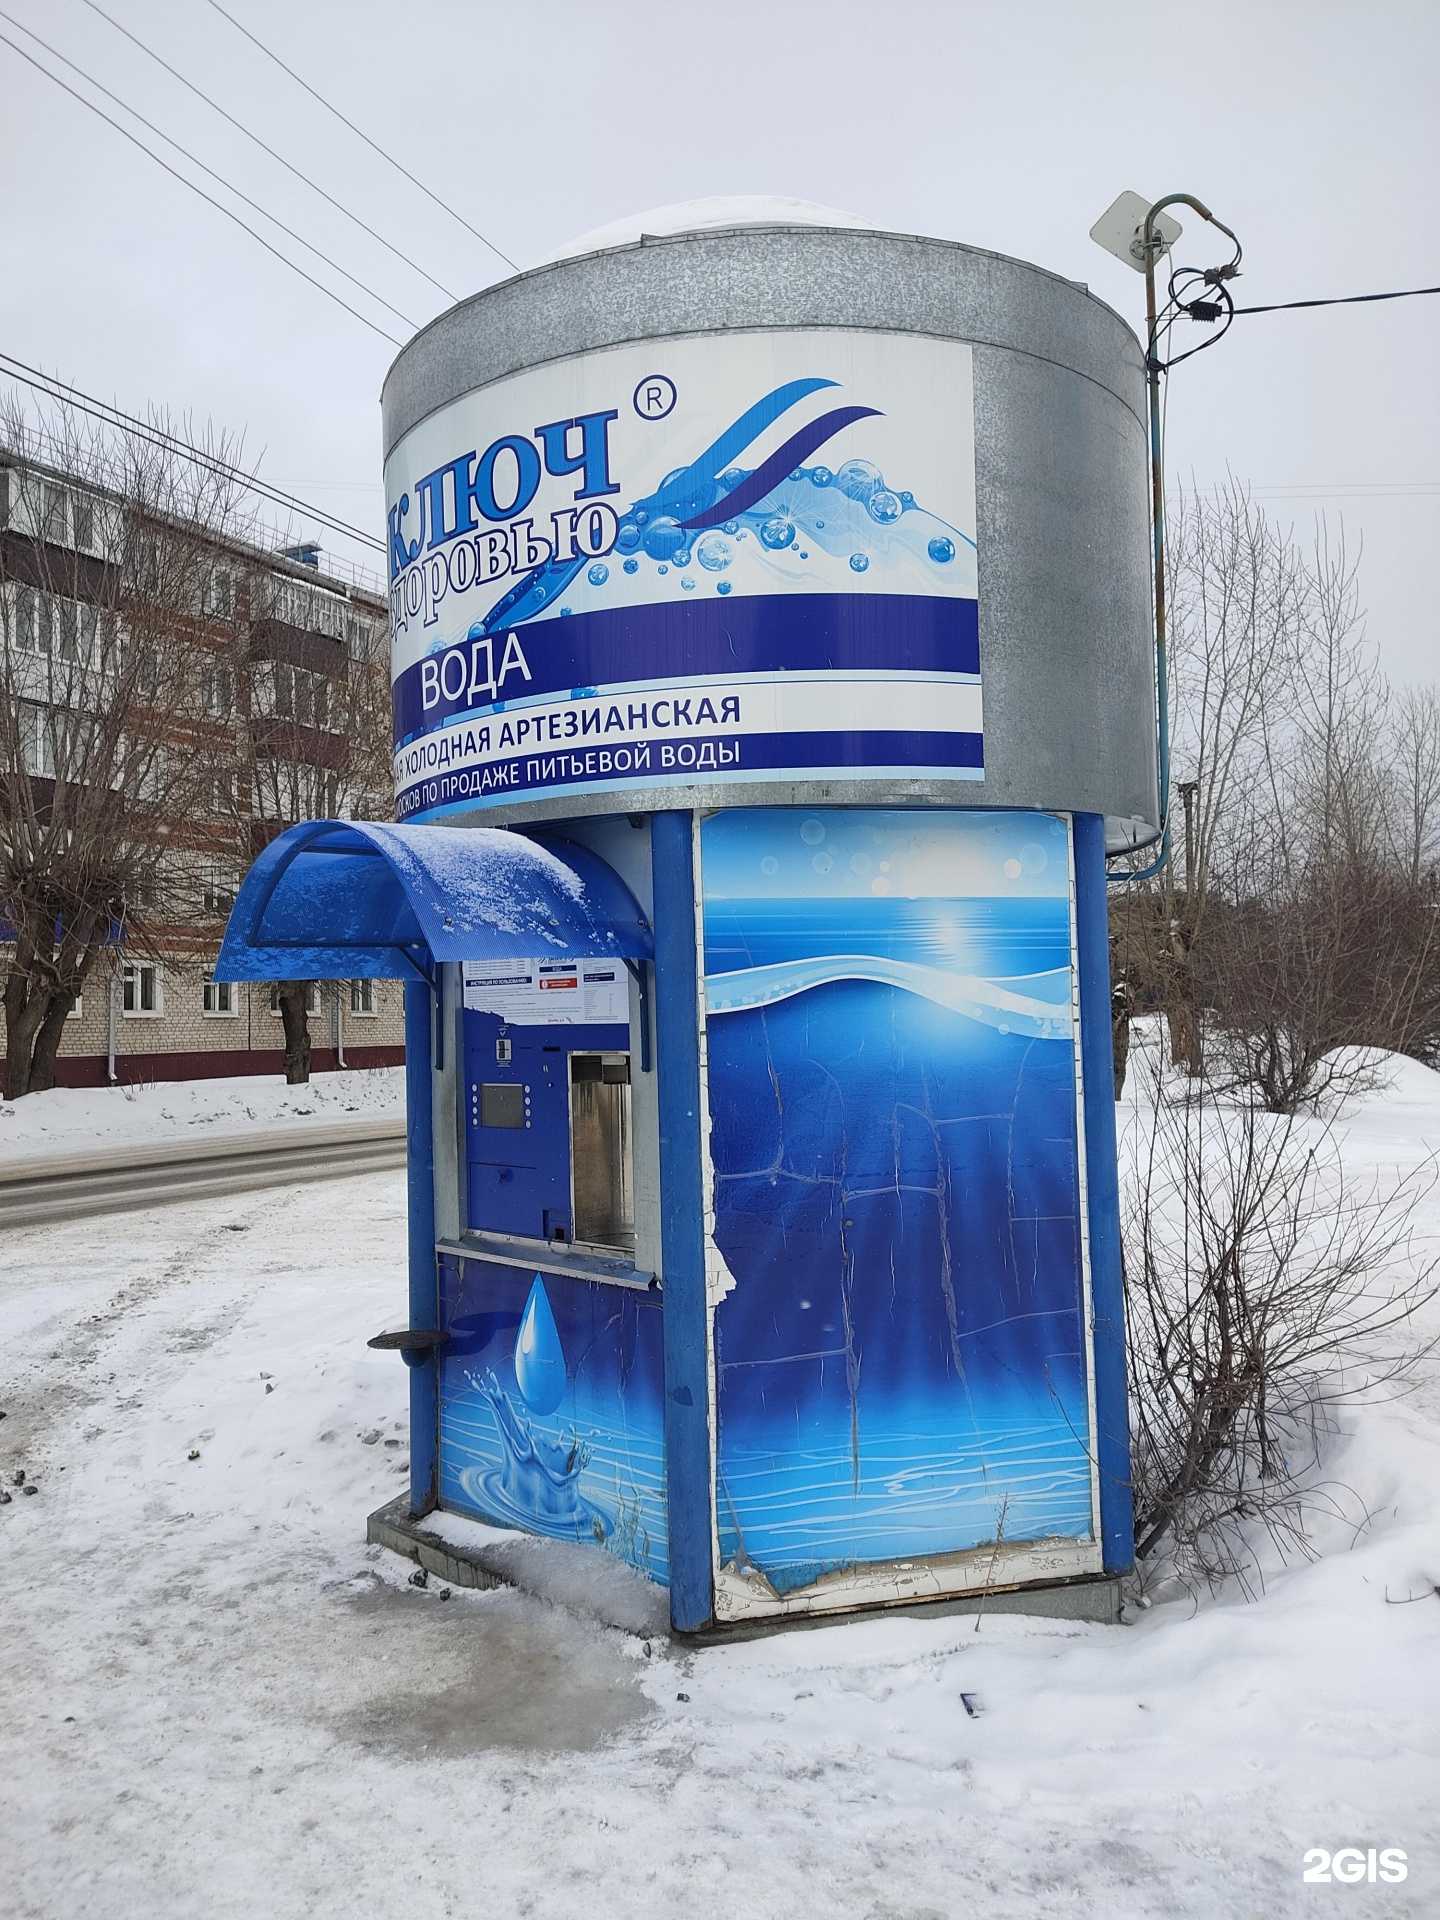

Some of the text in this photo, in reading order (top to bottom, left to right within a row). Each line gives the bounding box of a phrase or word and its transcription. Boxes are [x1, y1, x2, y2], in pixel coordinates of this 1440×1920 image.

[421, 632, 532, 711] ВОДА
[405, 726, 491, 778] ХОЛОДНАЯ
[498, 696, 741, 749] АРТЕЗИАНСКАЯ
[422, 782, 438, 805] ПО
[441, 763, 520, 799] ПРОДАЖЕ
[526, 742, 650, 782] ПИТЬЕВОЙ
[661, 741, 740, 770] ВОДЫ
